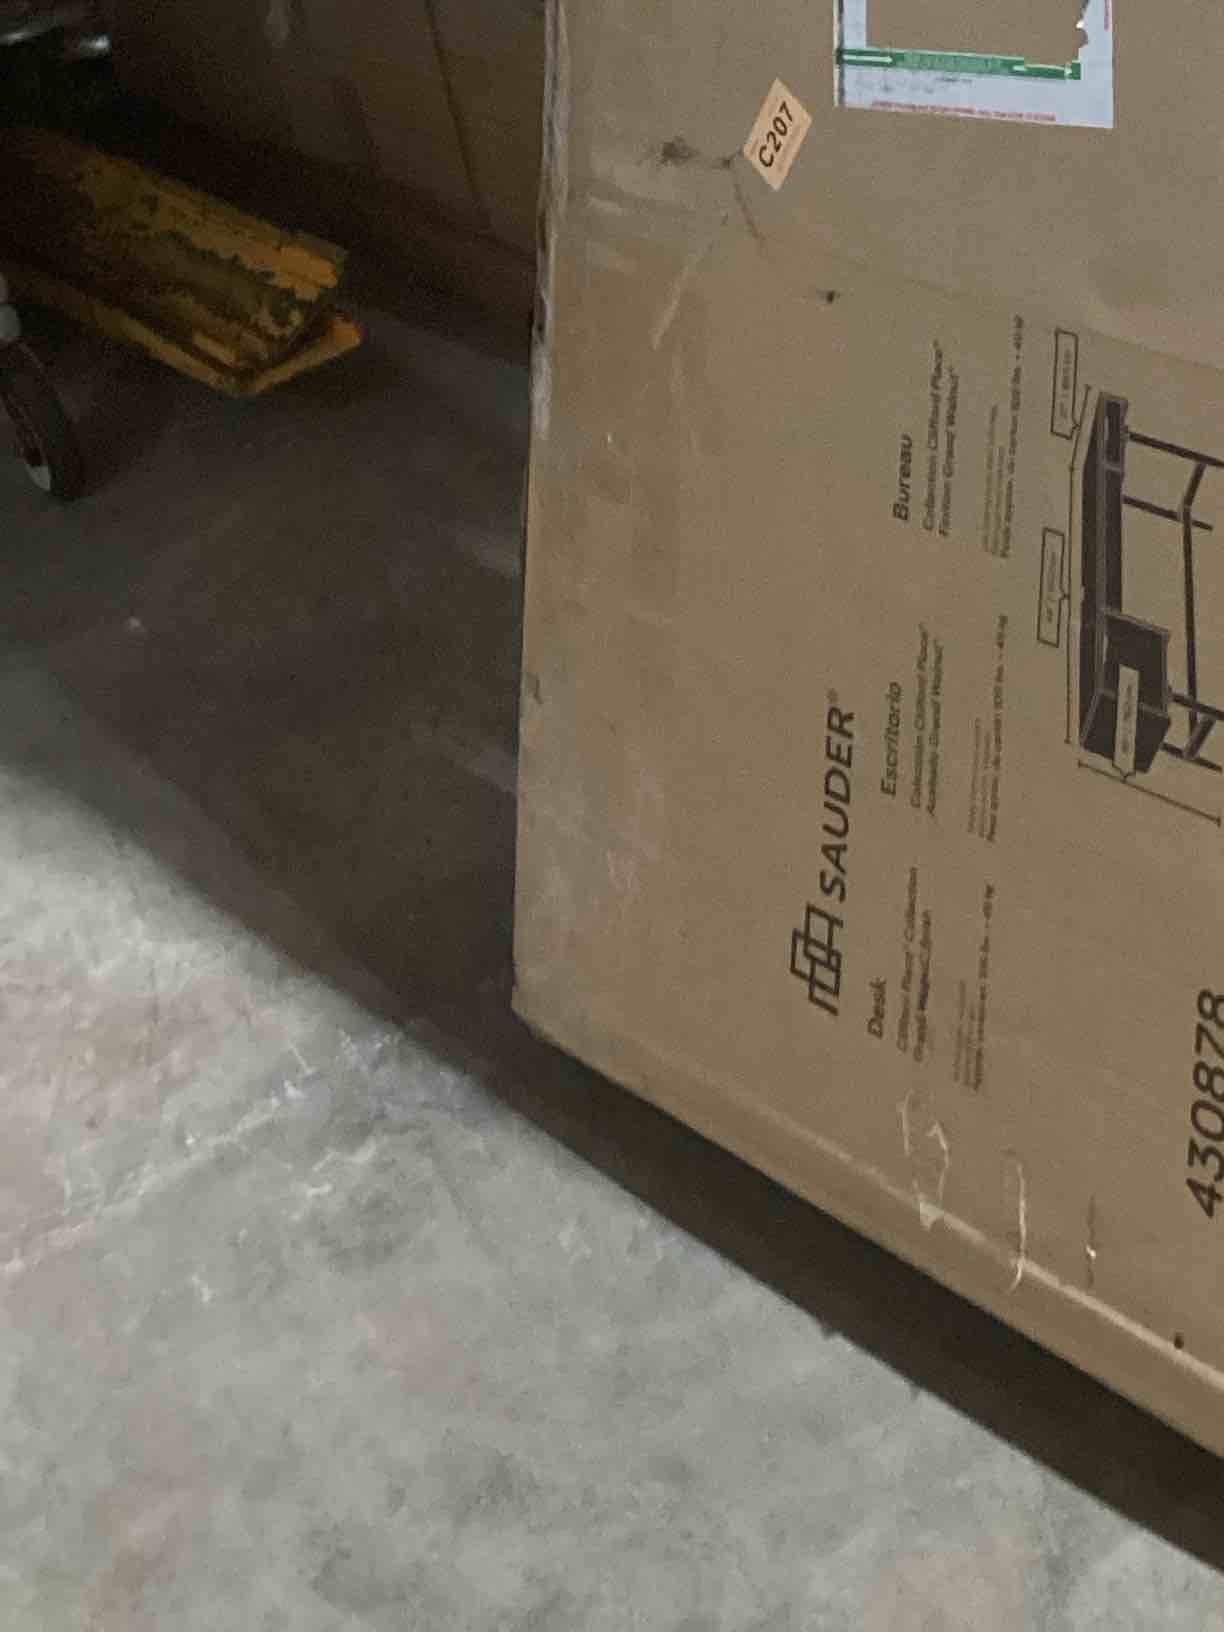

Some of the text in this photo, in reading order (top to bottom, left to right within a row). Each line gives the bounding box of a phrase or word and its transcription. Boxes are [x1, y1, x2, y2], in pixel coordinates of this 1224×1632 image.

[759, 100, 793, 168] C207
[892, 432, 913, 522] Bureau
[880, 681, 902, 798] Escritorio
[866, 976, 887, 1041] Desk
